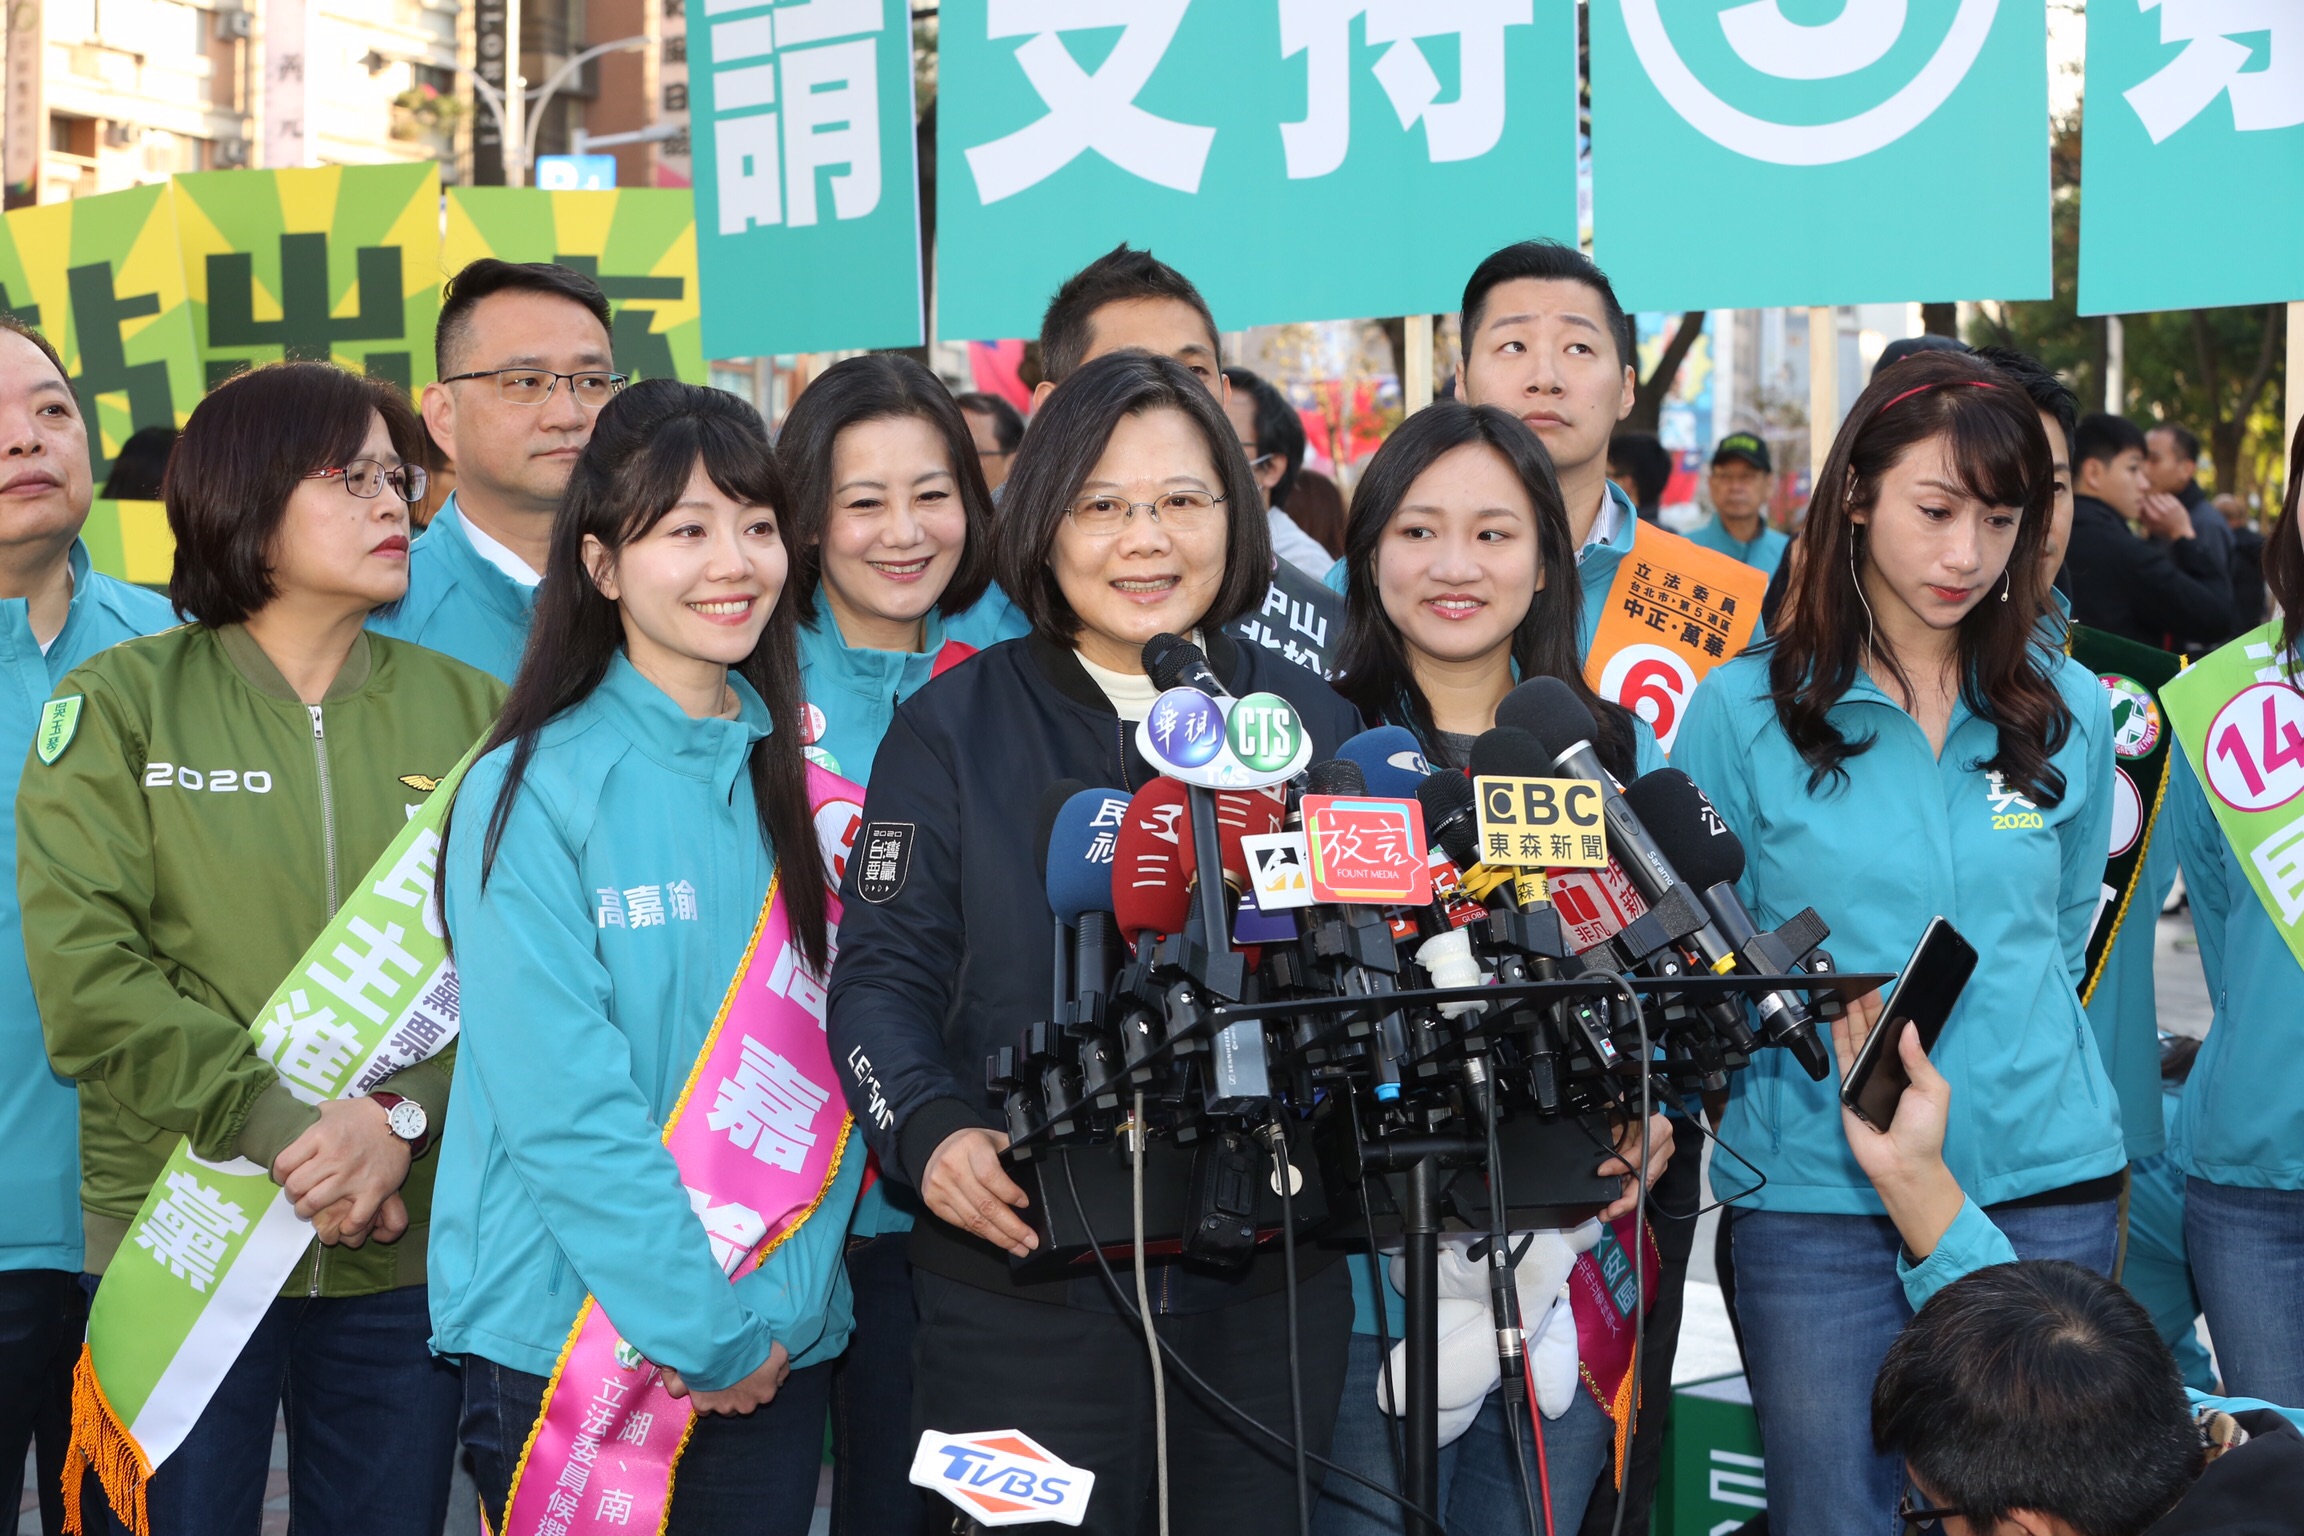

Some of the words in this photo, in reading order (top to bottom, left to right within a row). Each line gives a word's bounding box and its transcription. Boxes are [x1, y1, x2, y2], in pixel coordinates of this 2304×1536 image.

[1630, 580, 1670, 604] 台北市
[1679, 599, 1733, 634] 第5選區
[1634, 561, 1737, 617] 立法委員
[1619, 658, 1684, 741] 6
[1155, 701, 1218, 754] 華視
[1238, 706, 1291, 758] CTS
[2215, 693, 2304, 798] 14
[145, 762, 273, 794] 2020
[1487, 832, 1604, 860] 東森新聞
[1991, 812, 2044, 831] 2020
[1337, 868, 1368, 877] FOUNT
[1370, 870, 1399, 879] MEDIA
[596, 879, 699, 930] 高嘉瑜
[1574, 920, 1611, 943] 非凡
[938, 1444, 1072, 1506] TVBS
